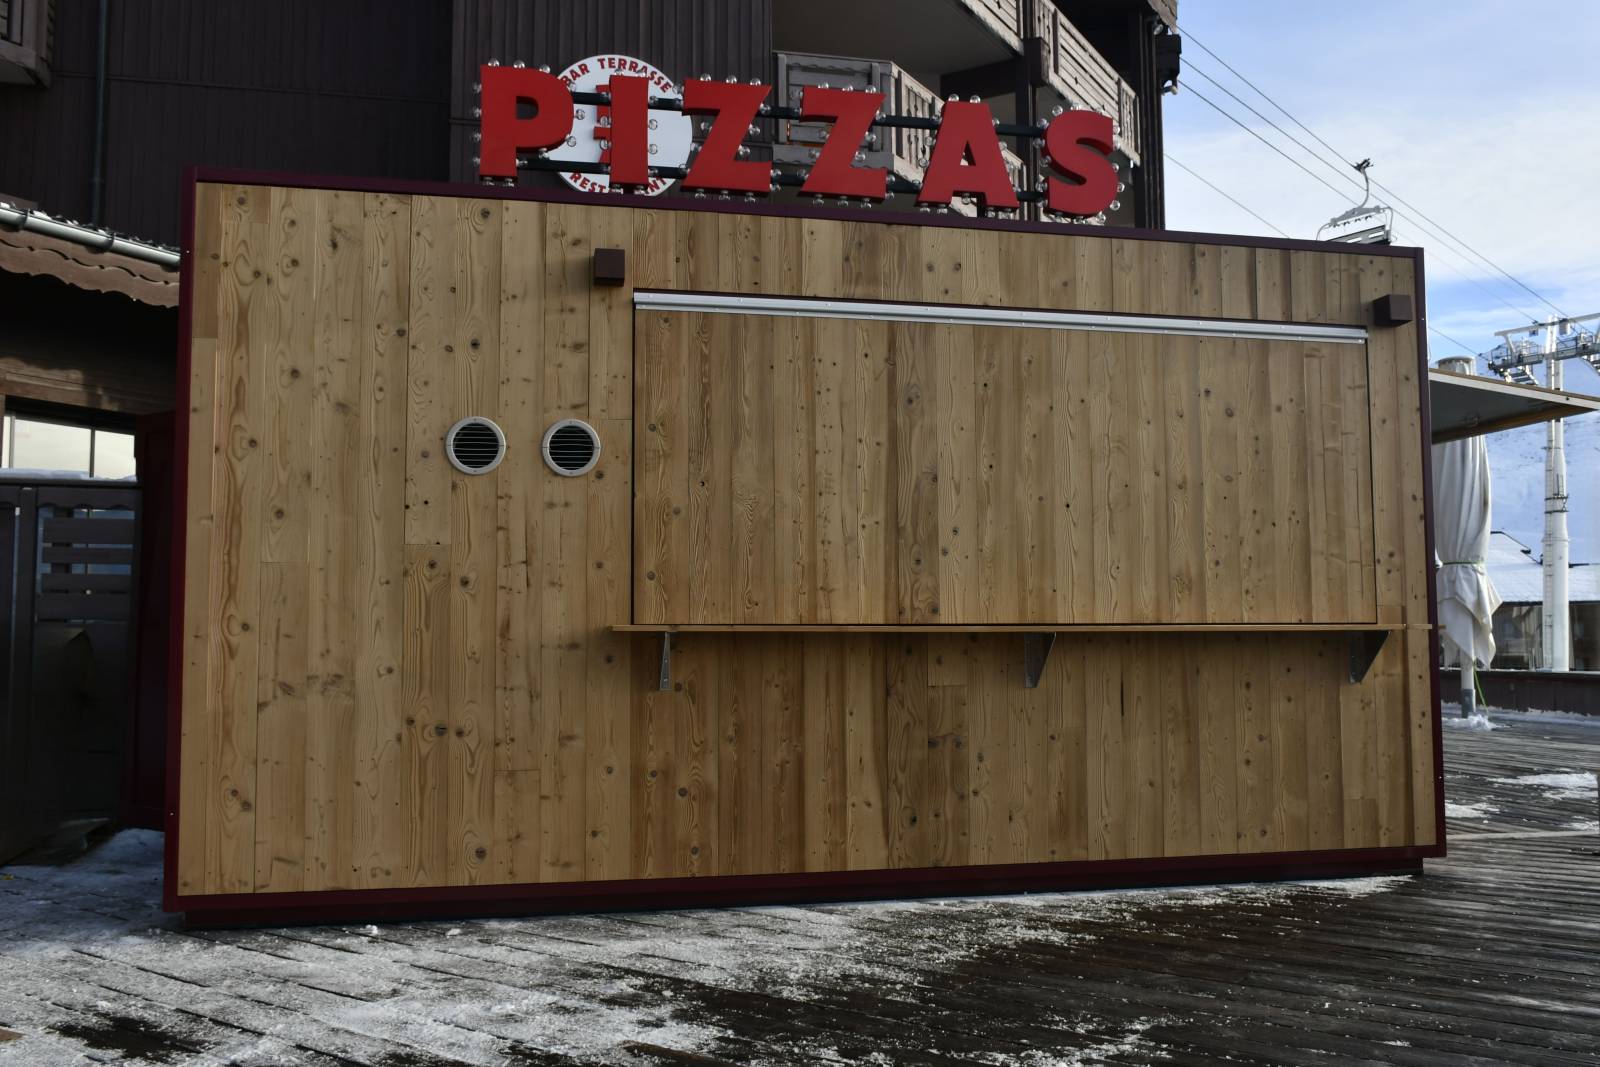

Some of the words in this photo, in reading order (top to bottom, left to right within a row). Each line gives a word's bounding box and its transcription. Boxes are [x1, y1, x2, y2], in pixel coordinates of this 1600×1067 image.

[561, 63, 590, 88] BAR
[597, 57, 673, 93] TERRASSE
[479, 64, 1119, 218] PIZZAS
